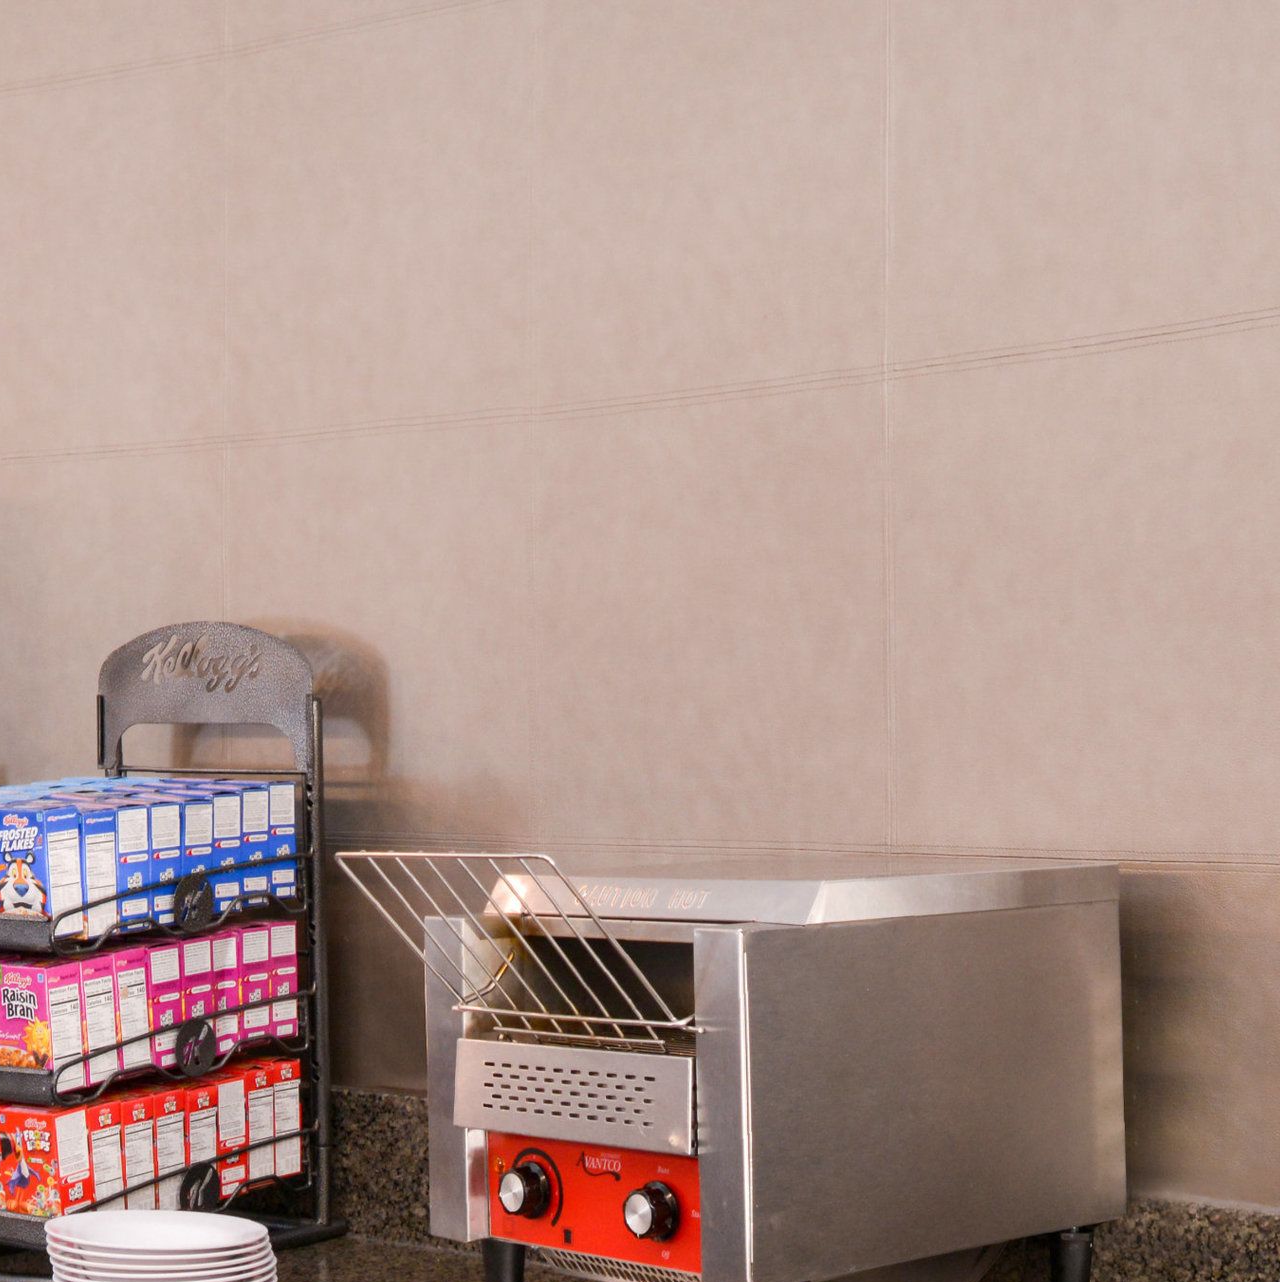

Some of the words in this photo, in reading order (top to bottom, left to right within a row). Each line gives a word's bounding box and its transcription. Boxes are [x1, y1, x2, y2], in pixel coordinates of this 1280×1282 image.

[140, 632, 261, 693] Kellogg's
[1, 839, 35, 852] FLAKES
[2, 989, 36, 1007] Raisin
[7, 1003, 33, 1020] Bran
[23, 1130, 50, 1141] FROOT
[26, 1140, 50, 1152] LOOPS
